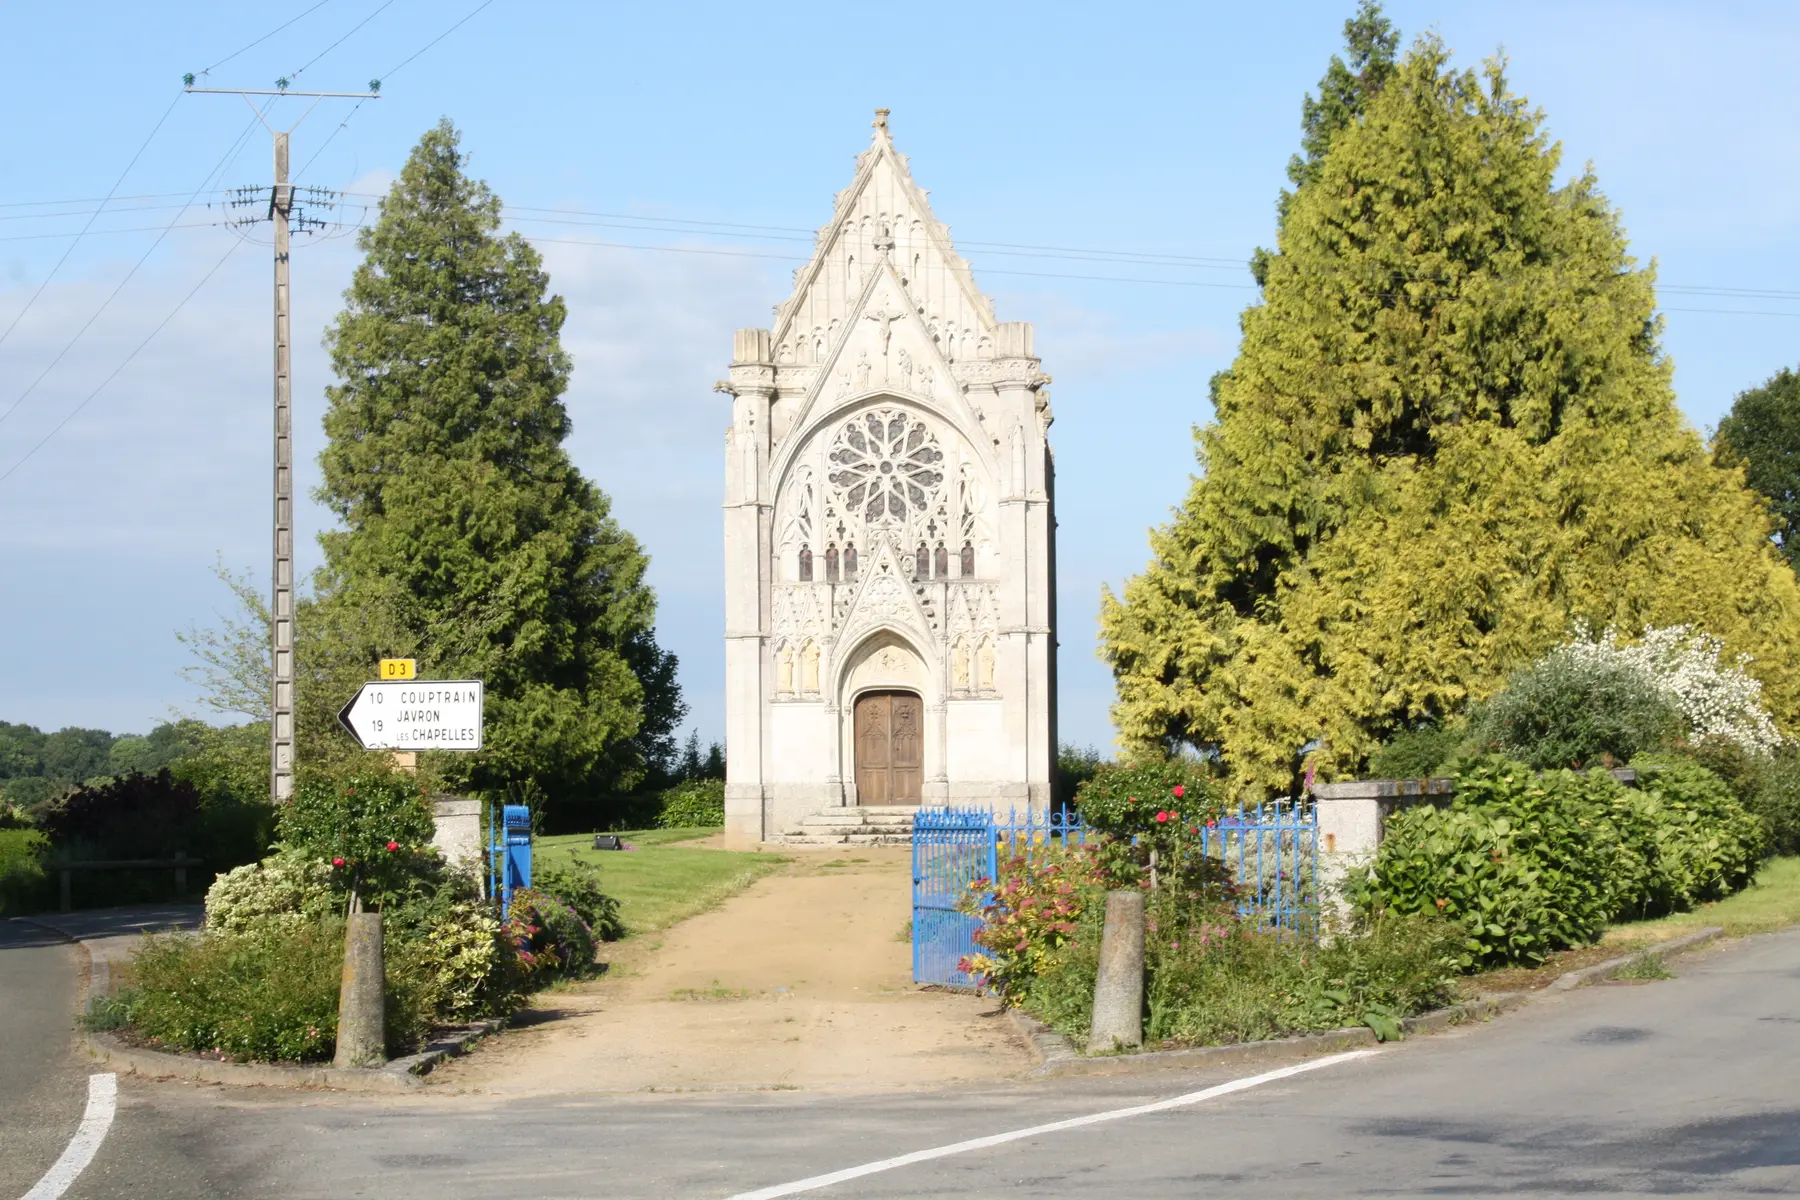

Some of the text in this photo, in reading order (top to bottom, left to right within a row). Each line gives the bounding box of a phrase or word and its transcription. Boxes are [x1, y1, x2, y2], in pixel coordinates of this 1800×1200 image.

[400, 664, 406, 675] 3
[370, 691, 476, 704] 10 COUPTRAIN
[397, 710, 440, 722] JAVRON
[372, 720, 383, 732] 19
[396, 728, 474, 741] LES CHAPELLES
